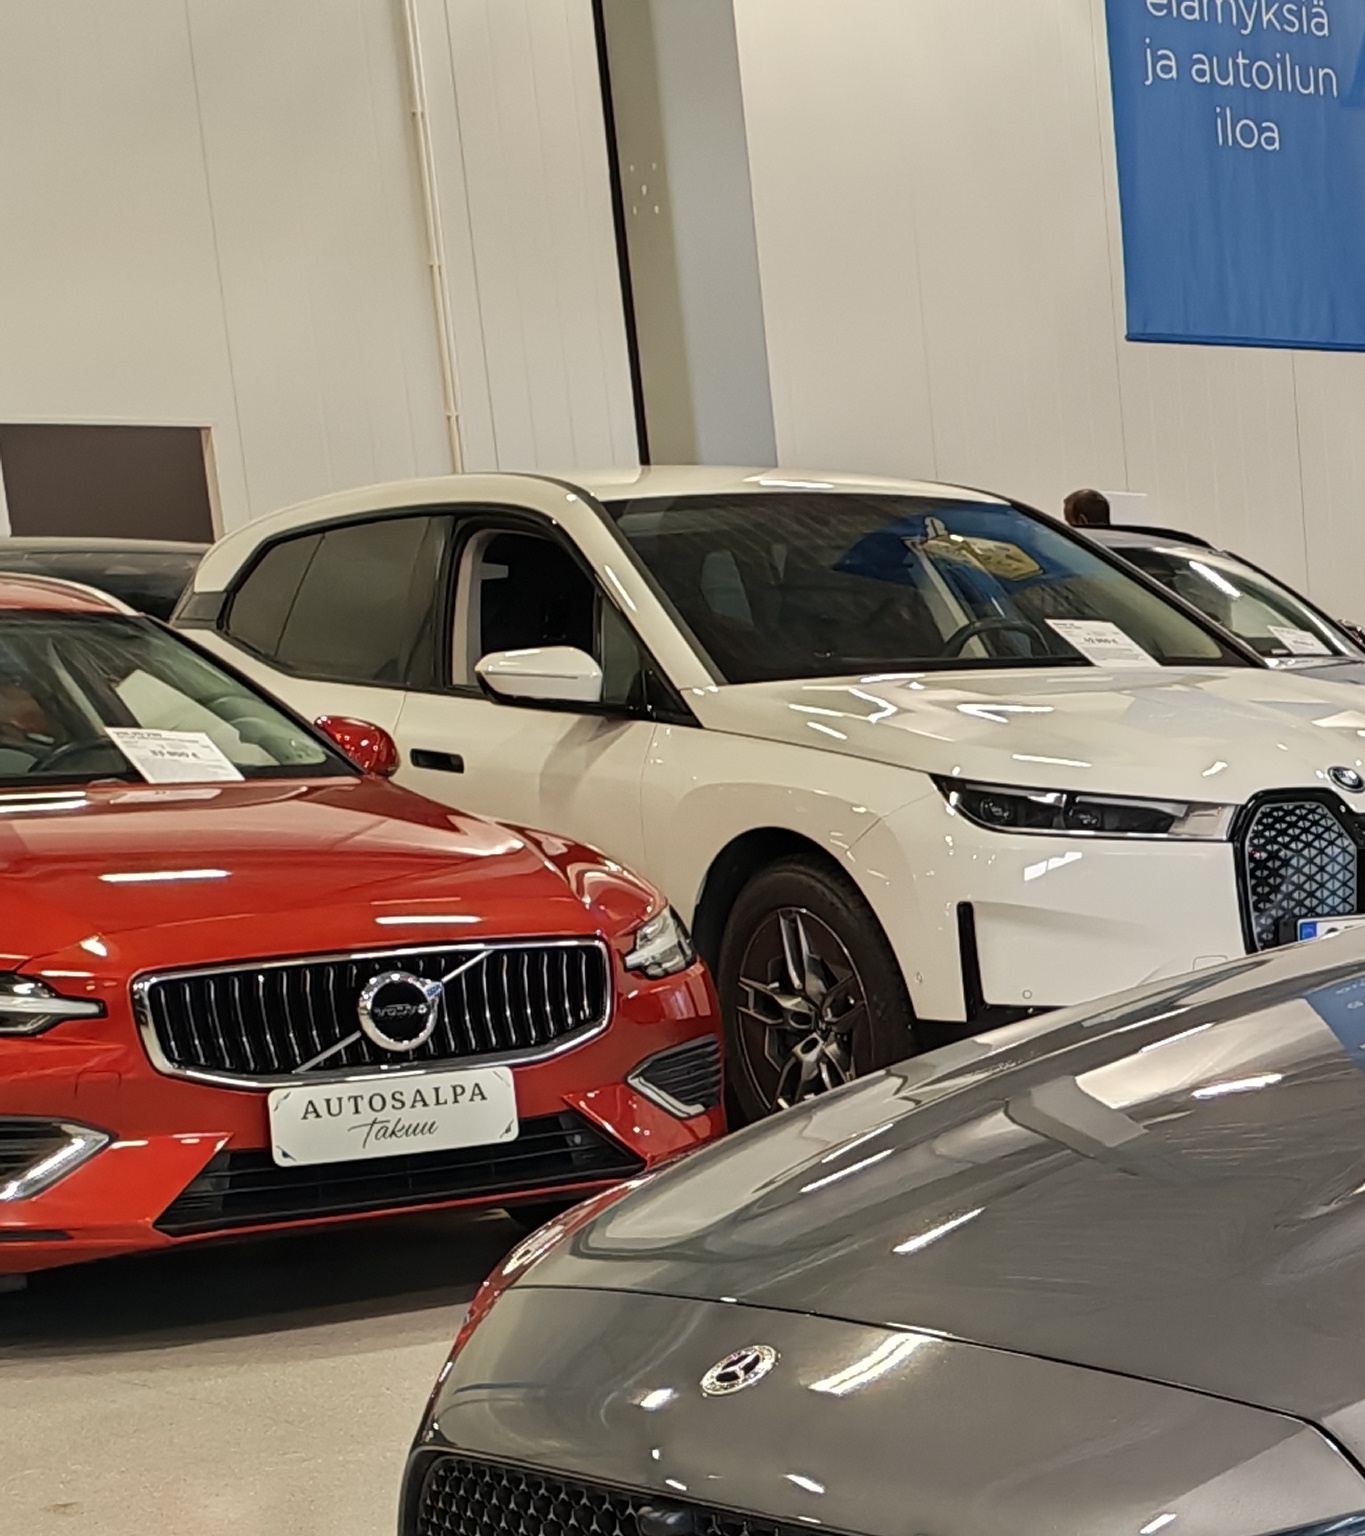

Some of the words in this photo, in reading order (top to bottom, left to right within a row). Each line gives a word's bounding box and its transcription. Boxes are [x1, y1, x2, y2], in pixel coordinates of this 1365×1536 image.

[1144, 37, 1178, 86] ja
[1190, 50, 1338, 99] autoilun
[1215, 106, 1280, 150] iloa
[300, 1082, 488, 1121] AUTOSALPA
[347, 1116, 440, 1149] Takuu
